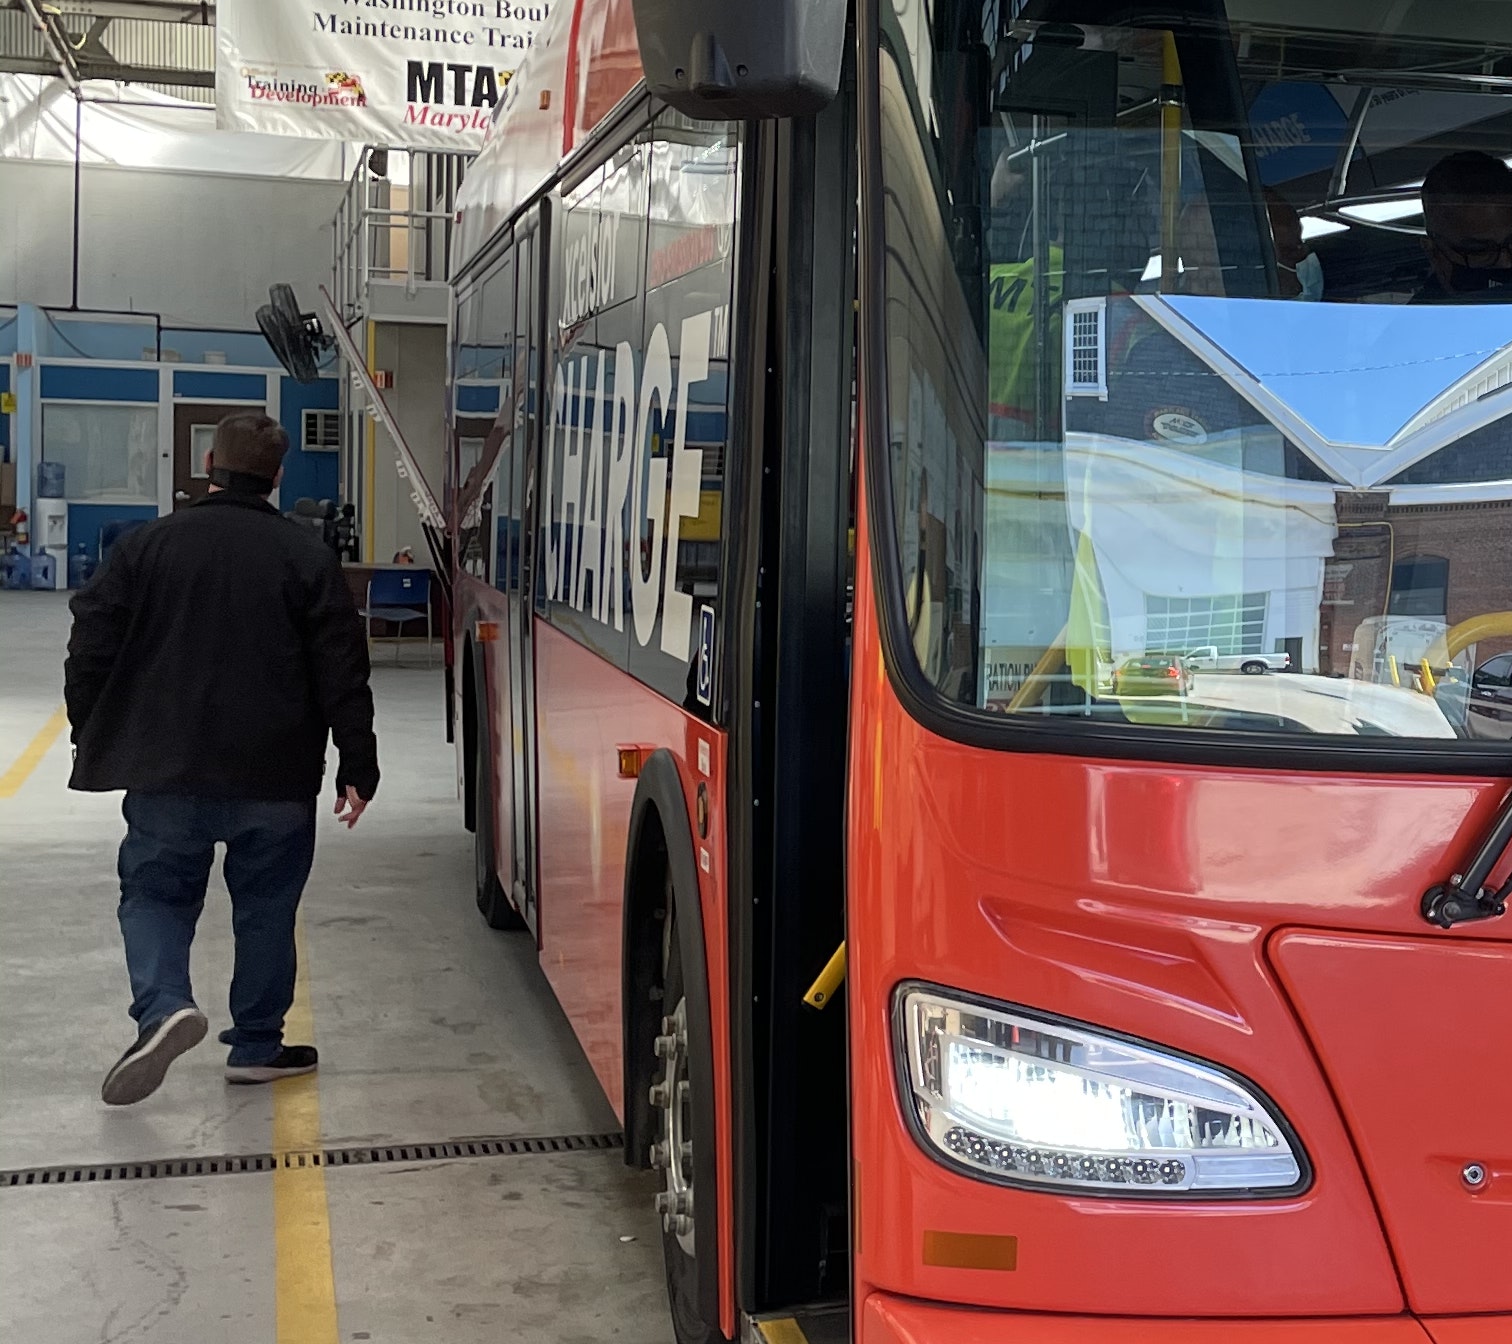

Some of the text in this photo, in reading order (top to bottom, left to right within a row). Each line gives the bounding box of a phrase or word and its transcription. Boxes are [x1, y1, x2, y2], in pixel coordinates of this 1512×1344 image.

[313, 11, 475, 43] Maintenance
[407, 60, 499, 108] MTA
[545, 311, 712, 663] CHARGE
